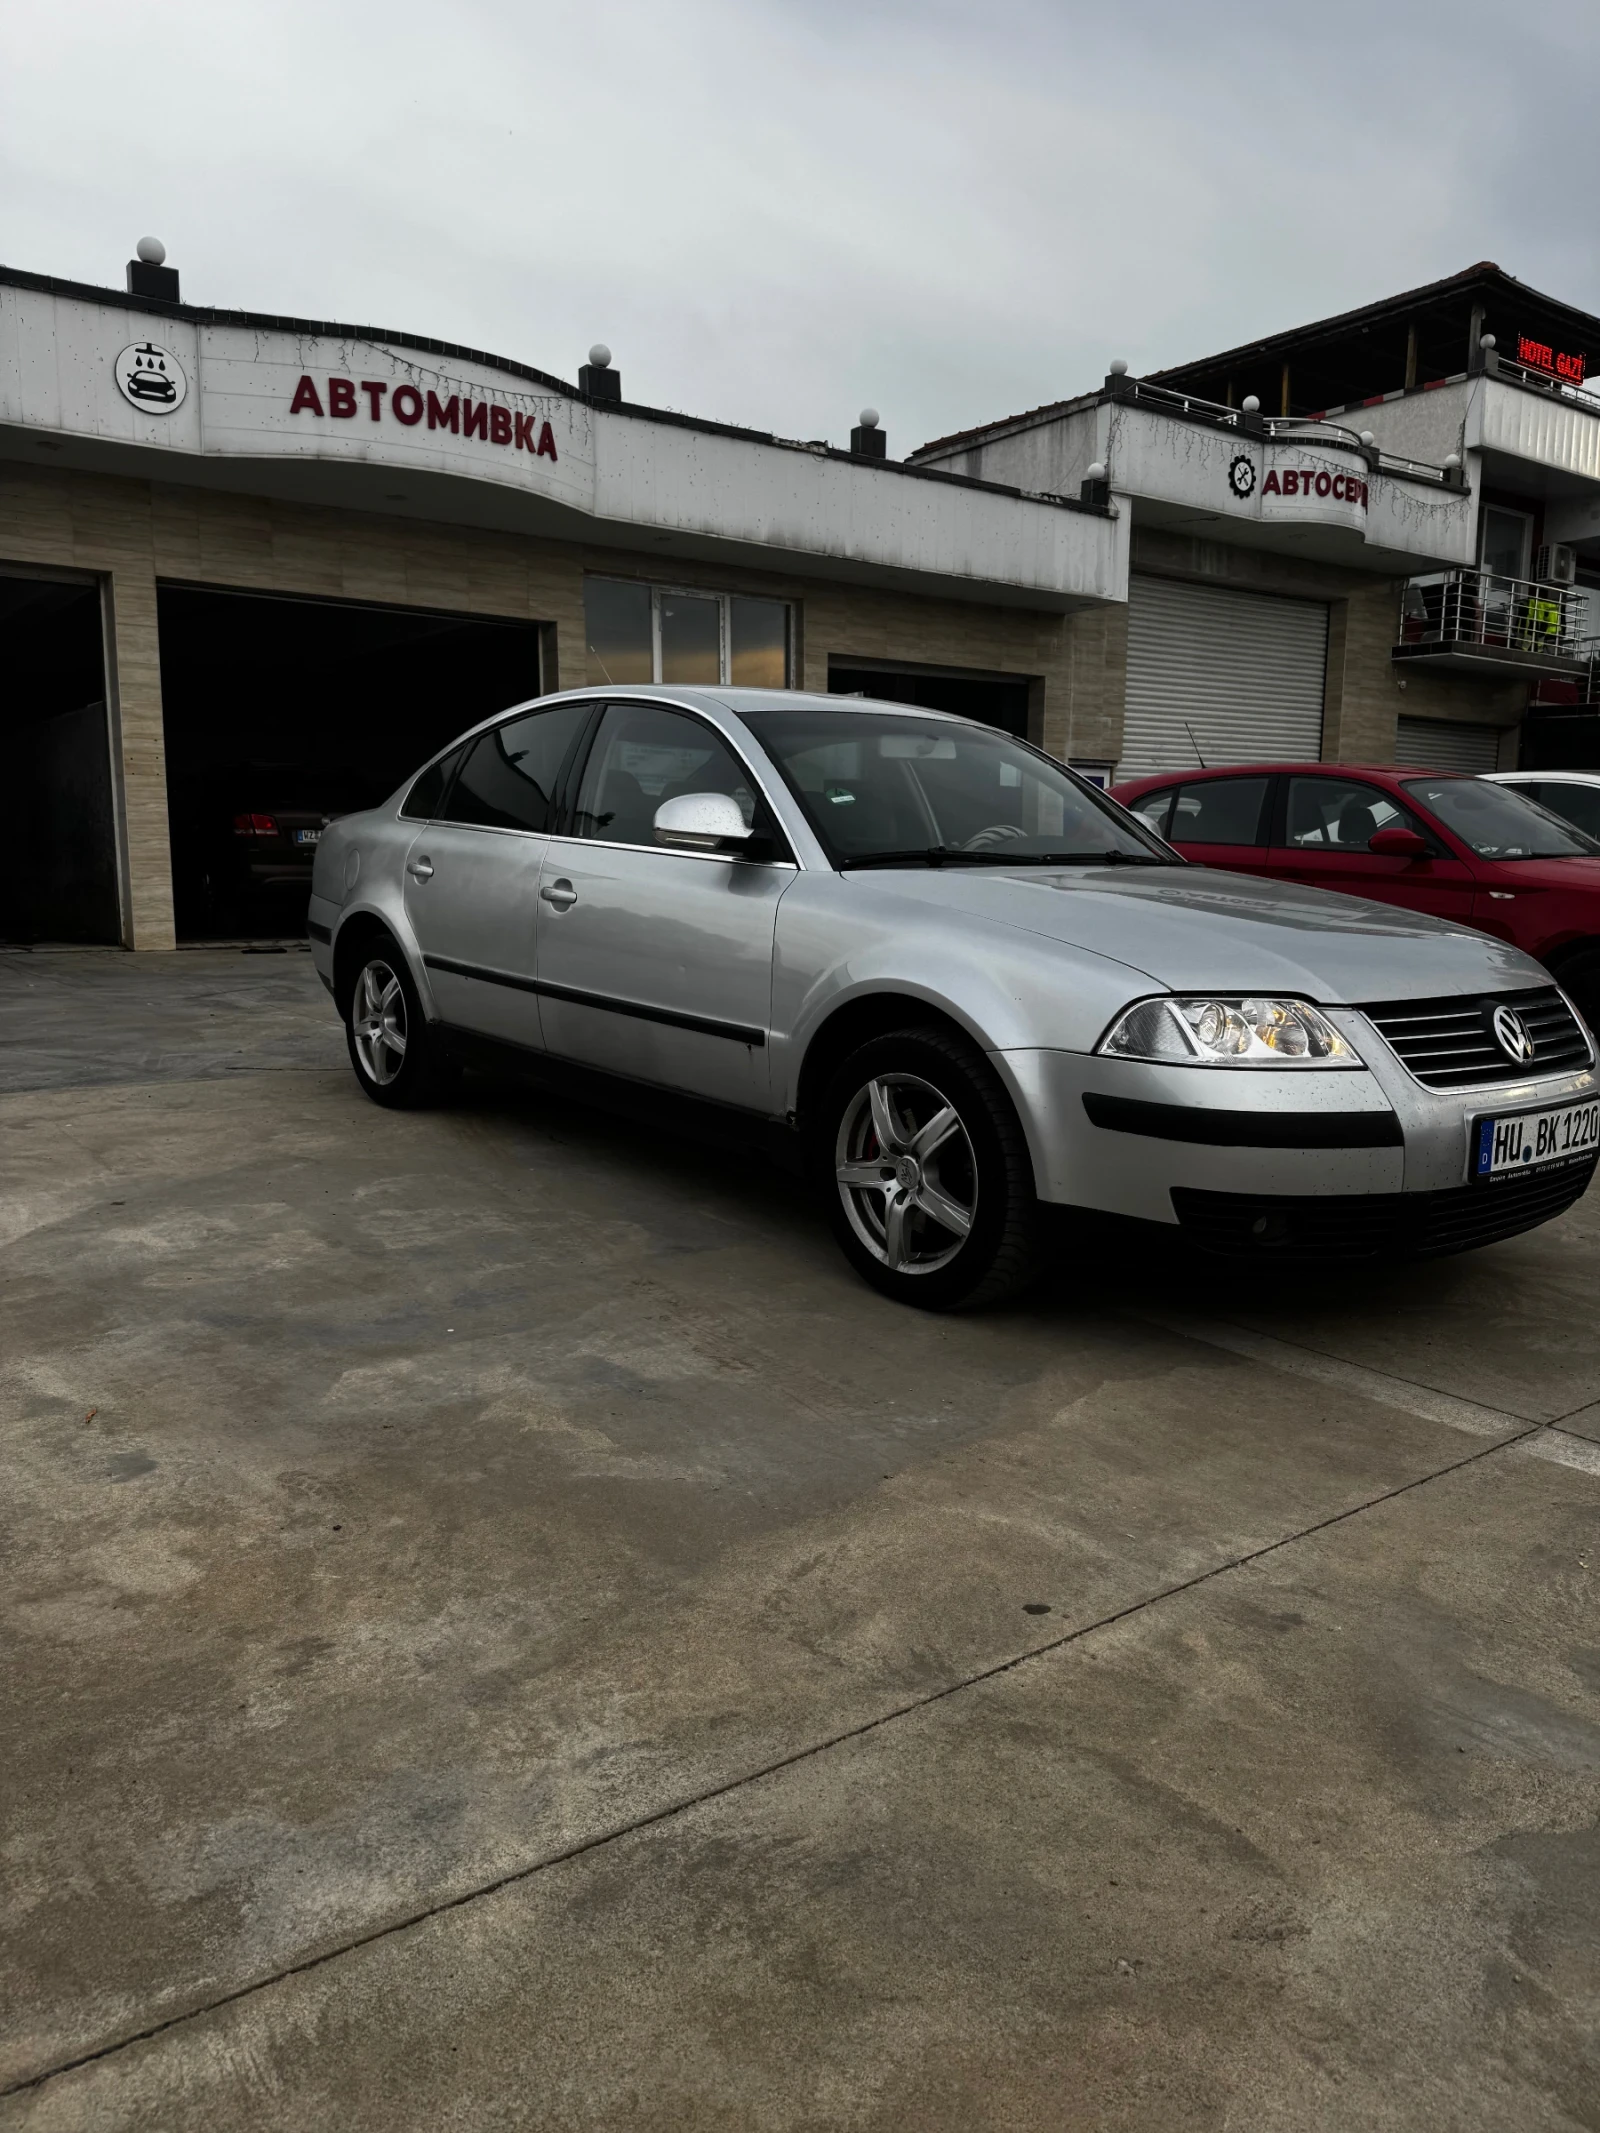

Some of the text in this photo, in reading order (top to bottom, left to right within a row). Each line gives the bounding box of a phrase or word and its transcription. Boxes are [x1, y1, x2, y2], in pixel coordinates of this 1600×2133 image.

[1519, 336, 1554, 370] HOTEL
[289, 374, 558, 462] АВТОМИВКА
[1494, 1121, 1524, 1165] HU
[1535, 1114, 1561, 1157] BK
[1561, 1105, 1599, 1150] 1220
